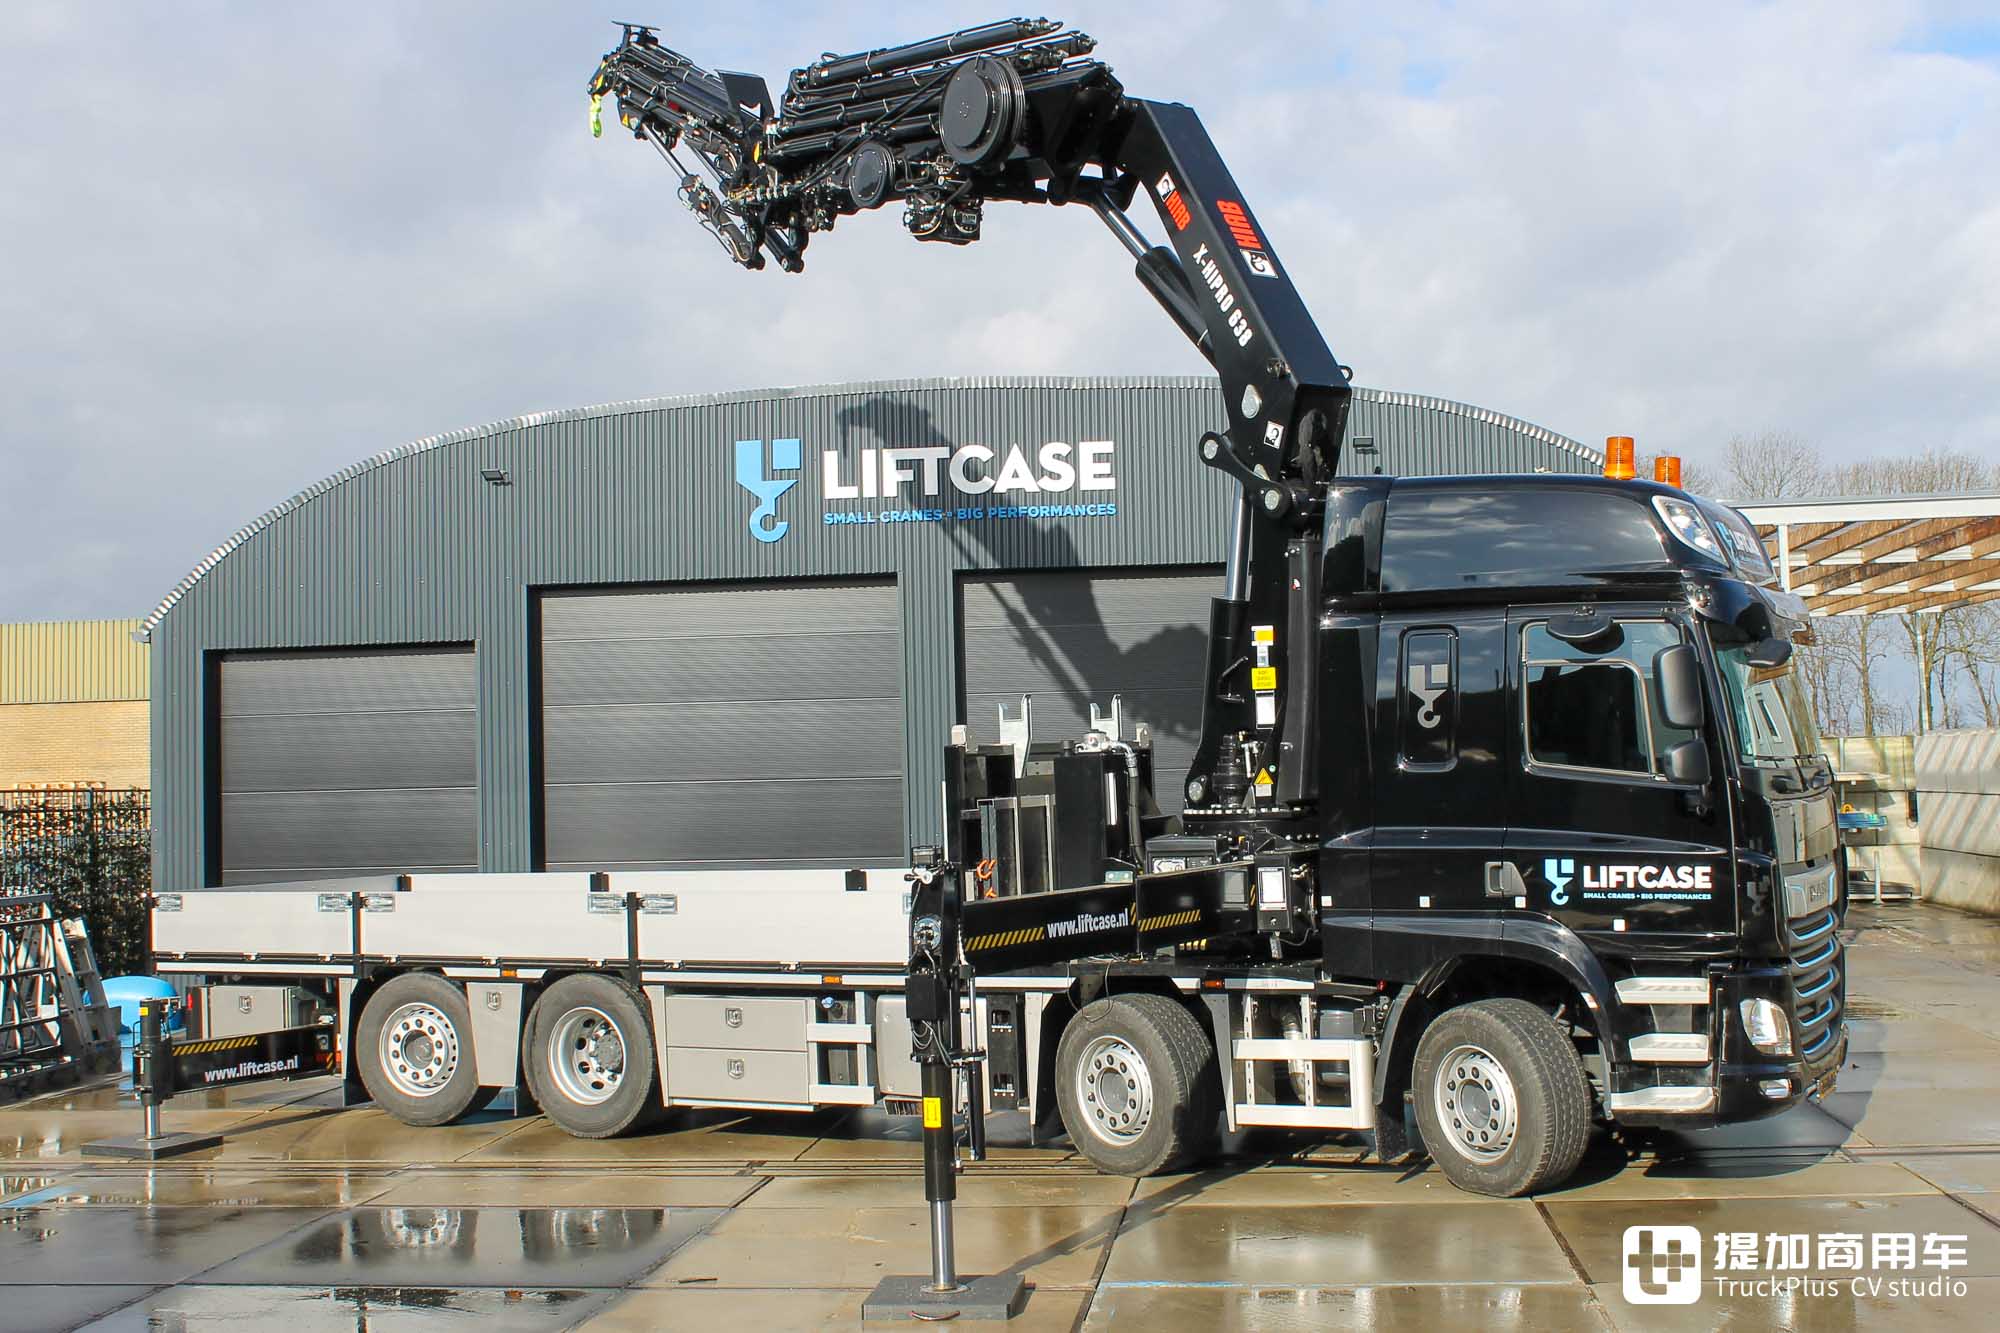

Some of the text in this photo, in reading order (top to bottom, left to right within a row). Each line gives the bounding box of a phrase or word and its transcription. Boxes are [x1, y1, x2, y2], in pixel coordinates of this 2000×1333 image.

[1164, 190, 1192, 231] HIAB
[1216, 199, 1263, 249] HIAB
[1192, 243, 1253, 347] X-HIPRO 638
[823, 441, 1116, 500] LIFTCASE
[824, 503, 1117, 525] SMALL CRANES BIG PERFORMANCES
[1583, 865, 1712, 889] LIFTCASE
[1640, 892, 1654, 900] BIG
[1047, 907, 1129, 938] www.liftcase.nl
[204, 1054, 299, 1083] www.liftcase.nl
